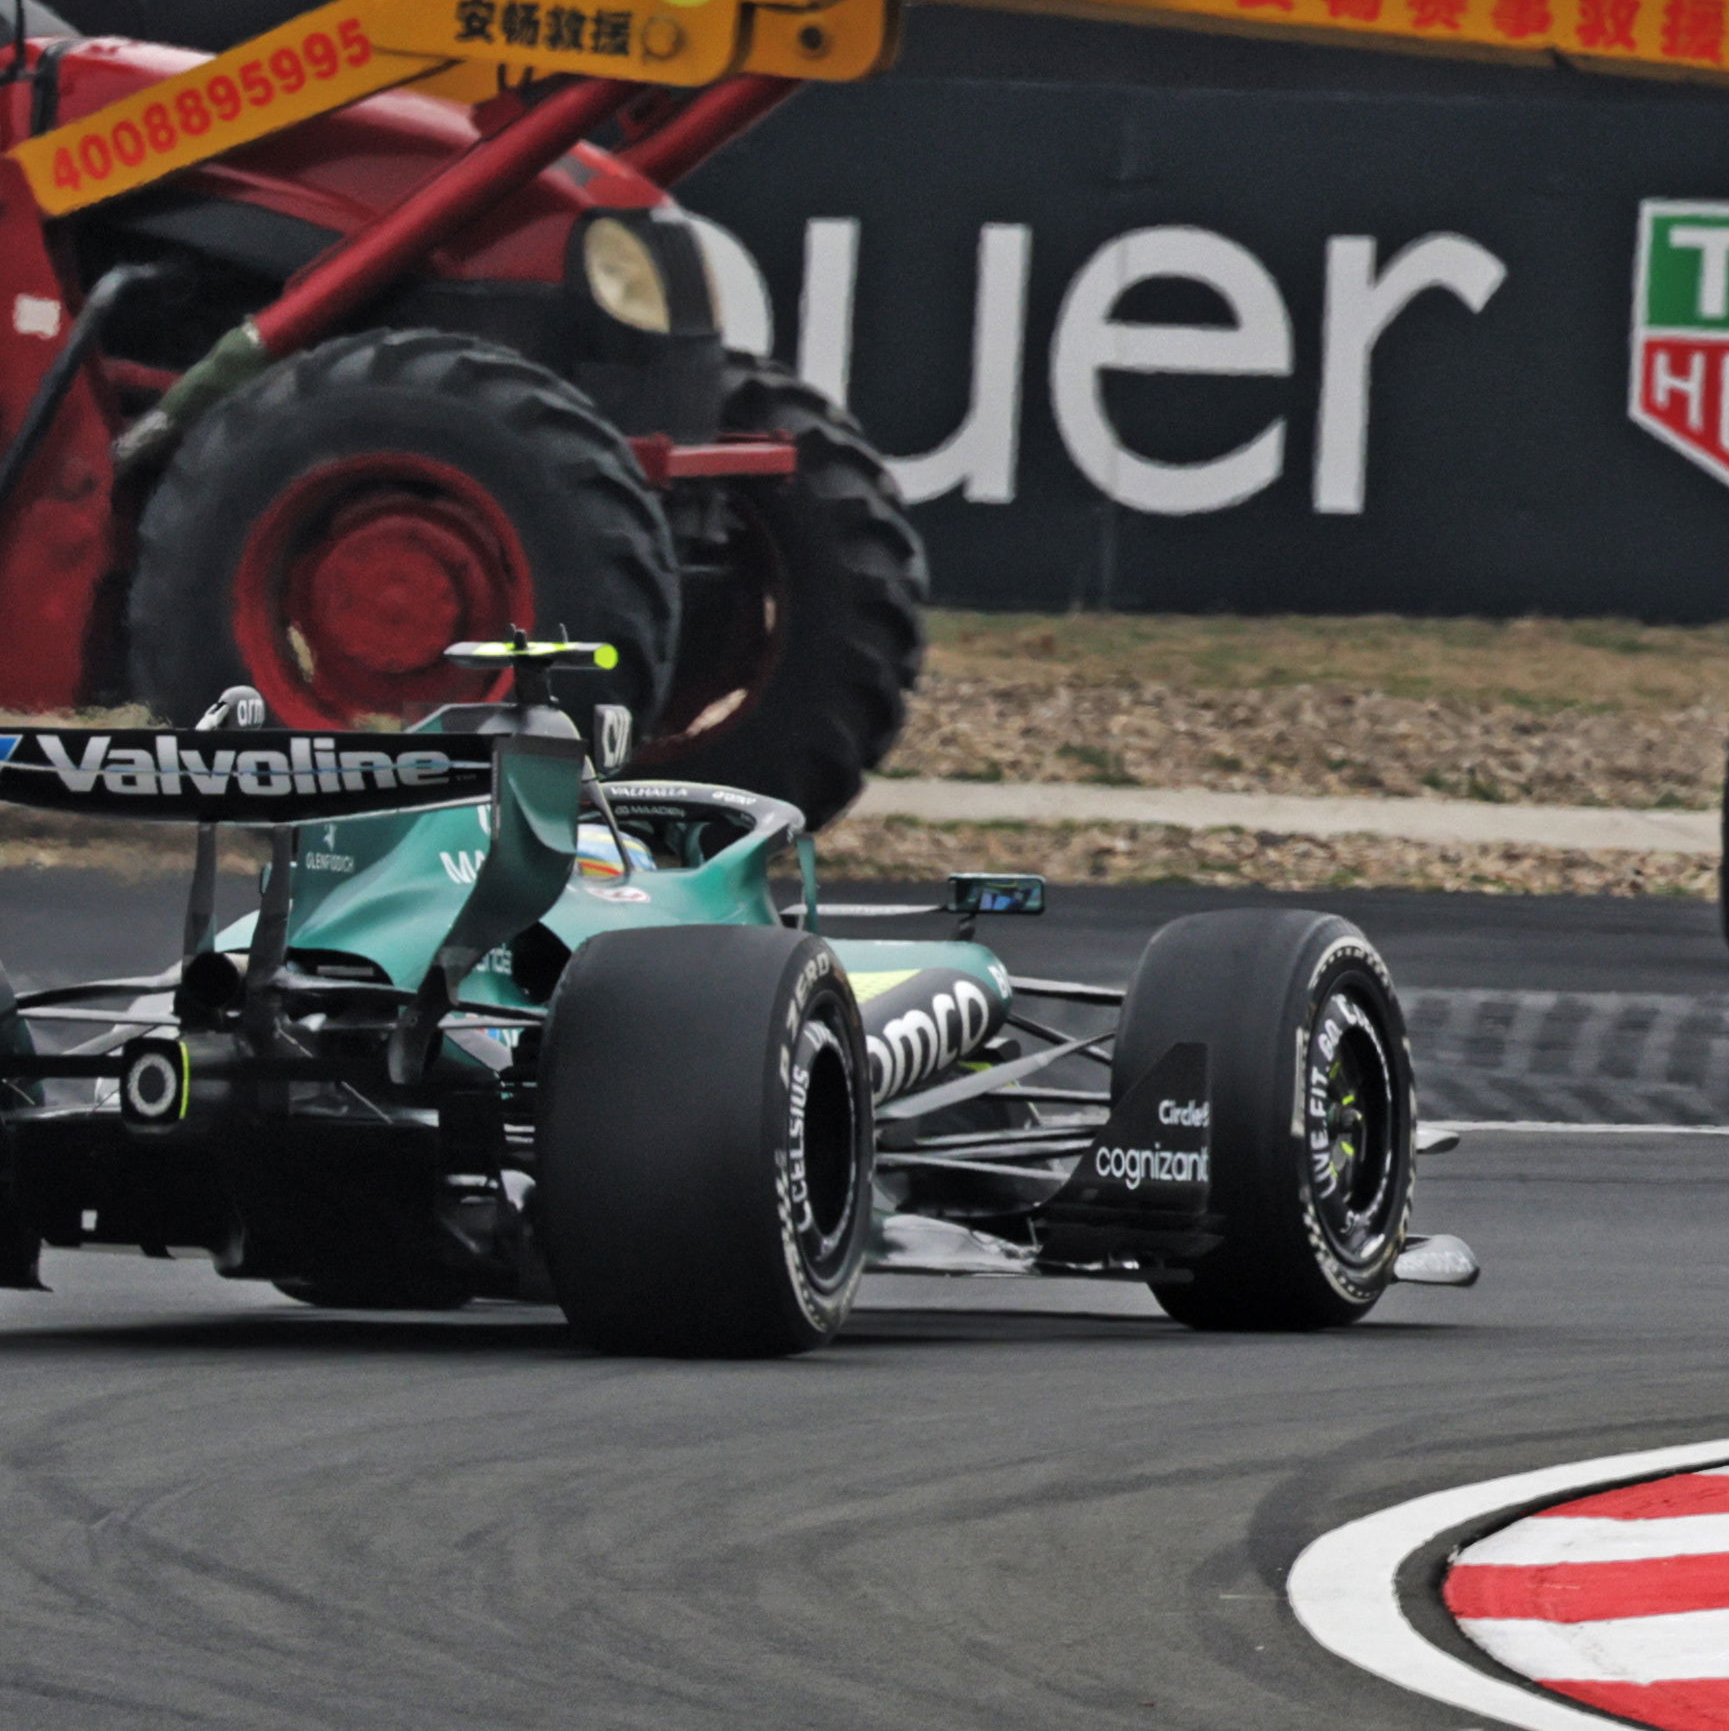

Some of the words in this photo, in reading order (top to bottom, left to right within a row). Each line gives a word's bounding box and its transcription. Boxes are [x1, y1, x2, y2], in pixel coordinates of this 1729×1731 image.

[51, 17, 372, 194] 4008895995
[652, 205, 1506, 515] uer
[36, 734, 450, 795] Valvoline
[1096, 1142, 1210, 1190] cognizant
